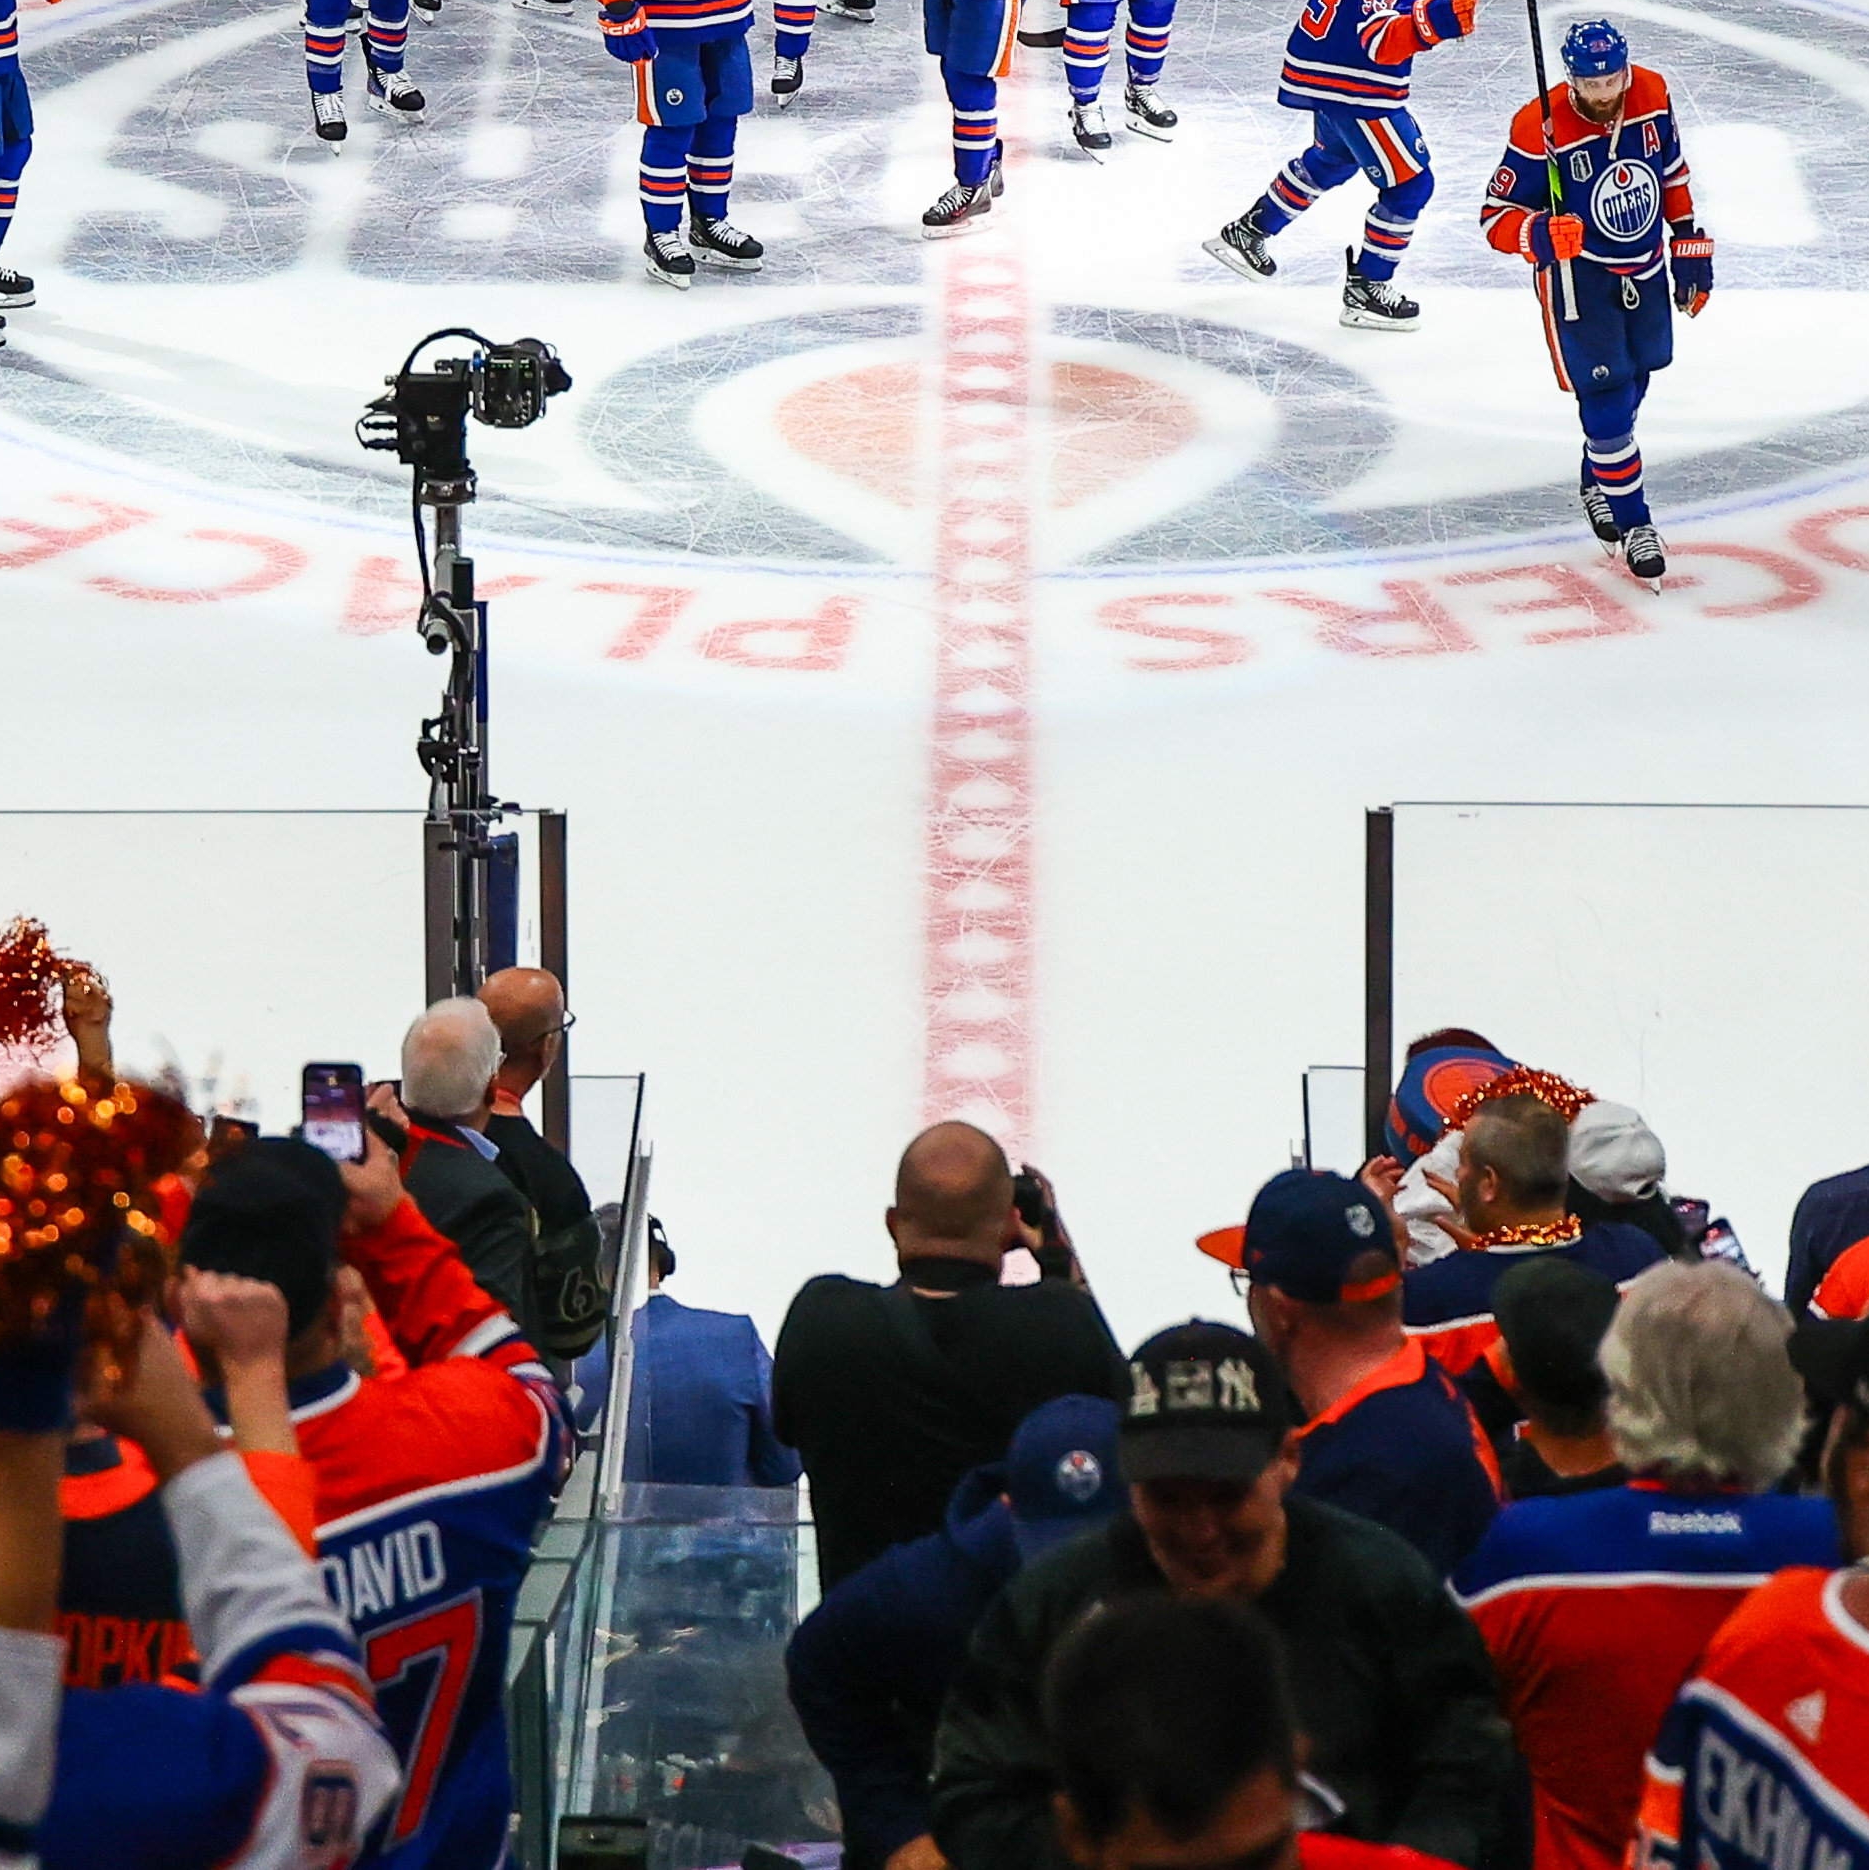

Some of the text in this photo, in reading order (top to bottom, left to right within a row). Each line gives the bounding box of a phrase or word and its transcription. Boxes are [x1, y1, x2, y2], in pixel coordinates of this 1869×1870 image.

[1642, 120, 1661, 159] A
[1602, 180, 1652, 216] OILERS
[1649, 1511, 1743, 1535] Reebok
